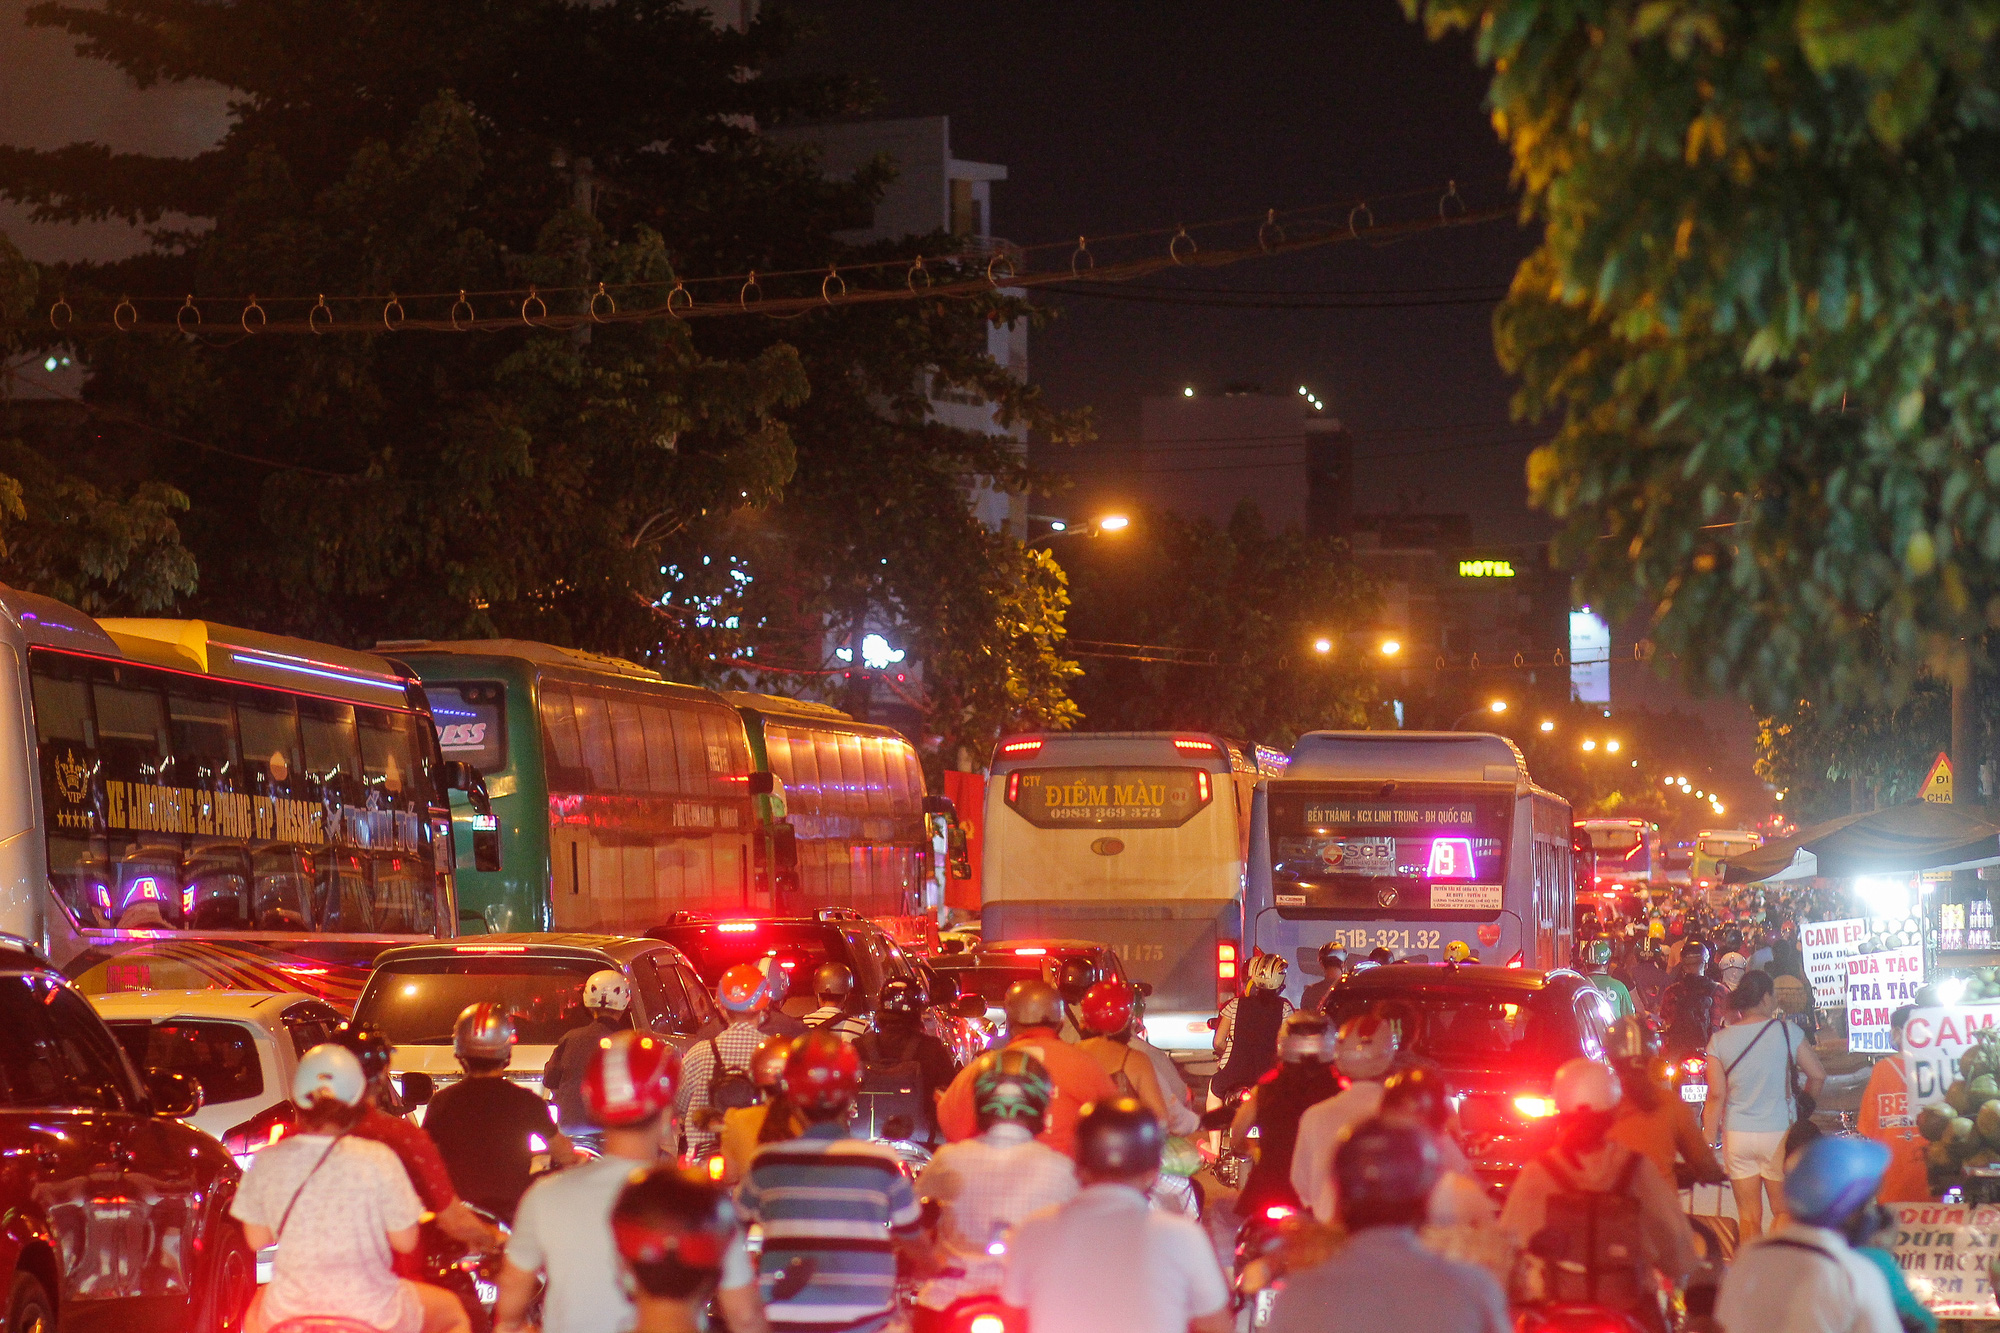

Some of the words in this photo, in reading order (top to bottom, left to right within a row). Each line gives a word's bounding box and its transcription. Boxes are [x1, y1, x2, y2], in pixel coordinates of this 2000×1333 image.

[1459, 560, 1515, 577] HOTEL
[1023, 775, 1041, 787] CTY
[1936, 775, 1949, 784] ĐI
[67, 791, 82, 803] VIP
[1045, 777, 1109, 807] ĐIỂM
[1113, 779, 1166, 807] MÀU
[1927, 790, 1952, 802] CHÂ
[106, 780, 126, 828] XE
[127, 782, 196, 834] LIMOUSINE
[196, 789, 214, 835] 22
[253, 795, 274, 840] VIP
[275, 798, 325, 845] MASSAGE
[1096, 807, 1126, 819] 369
[1131, 807, 1162, 819] 373
[1307, 805, 1324, 822] BẾN
[1325, 807, 1351, 823] THÀNH
[1357, 810, 1373, 822] KCX
[1374, 810, 1392, 823] LINH
[1394, 810, 1419, 823] TRUNG
[1425, 810, 1436, 823] ĐH
[1438, 806, 1459, 824] QUỐC
[1460, 811, 1473, 823] GIA
[1345, 844, 1389, 858] SCB
[1335, 929, 1440, 949] 51B-321.32
[1805, 927, 1840, 947] CAM
[1844, 921, 1862, 943] ÉP
[1850, 977, 1882, 1001] TRÀ
[1850, 1007, 1890, 1026] CAM
